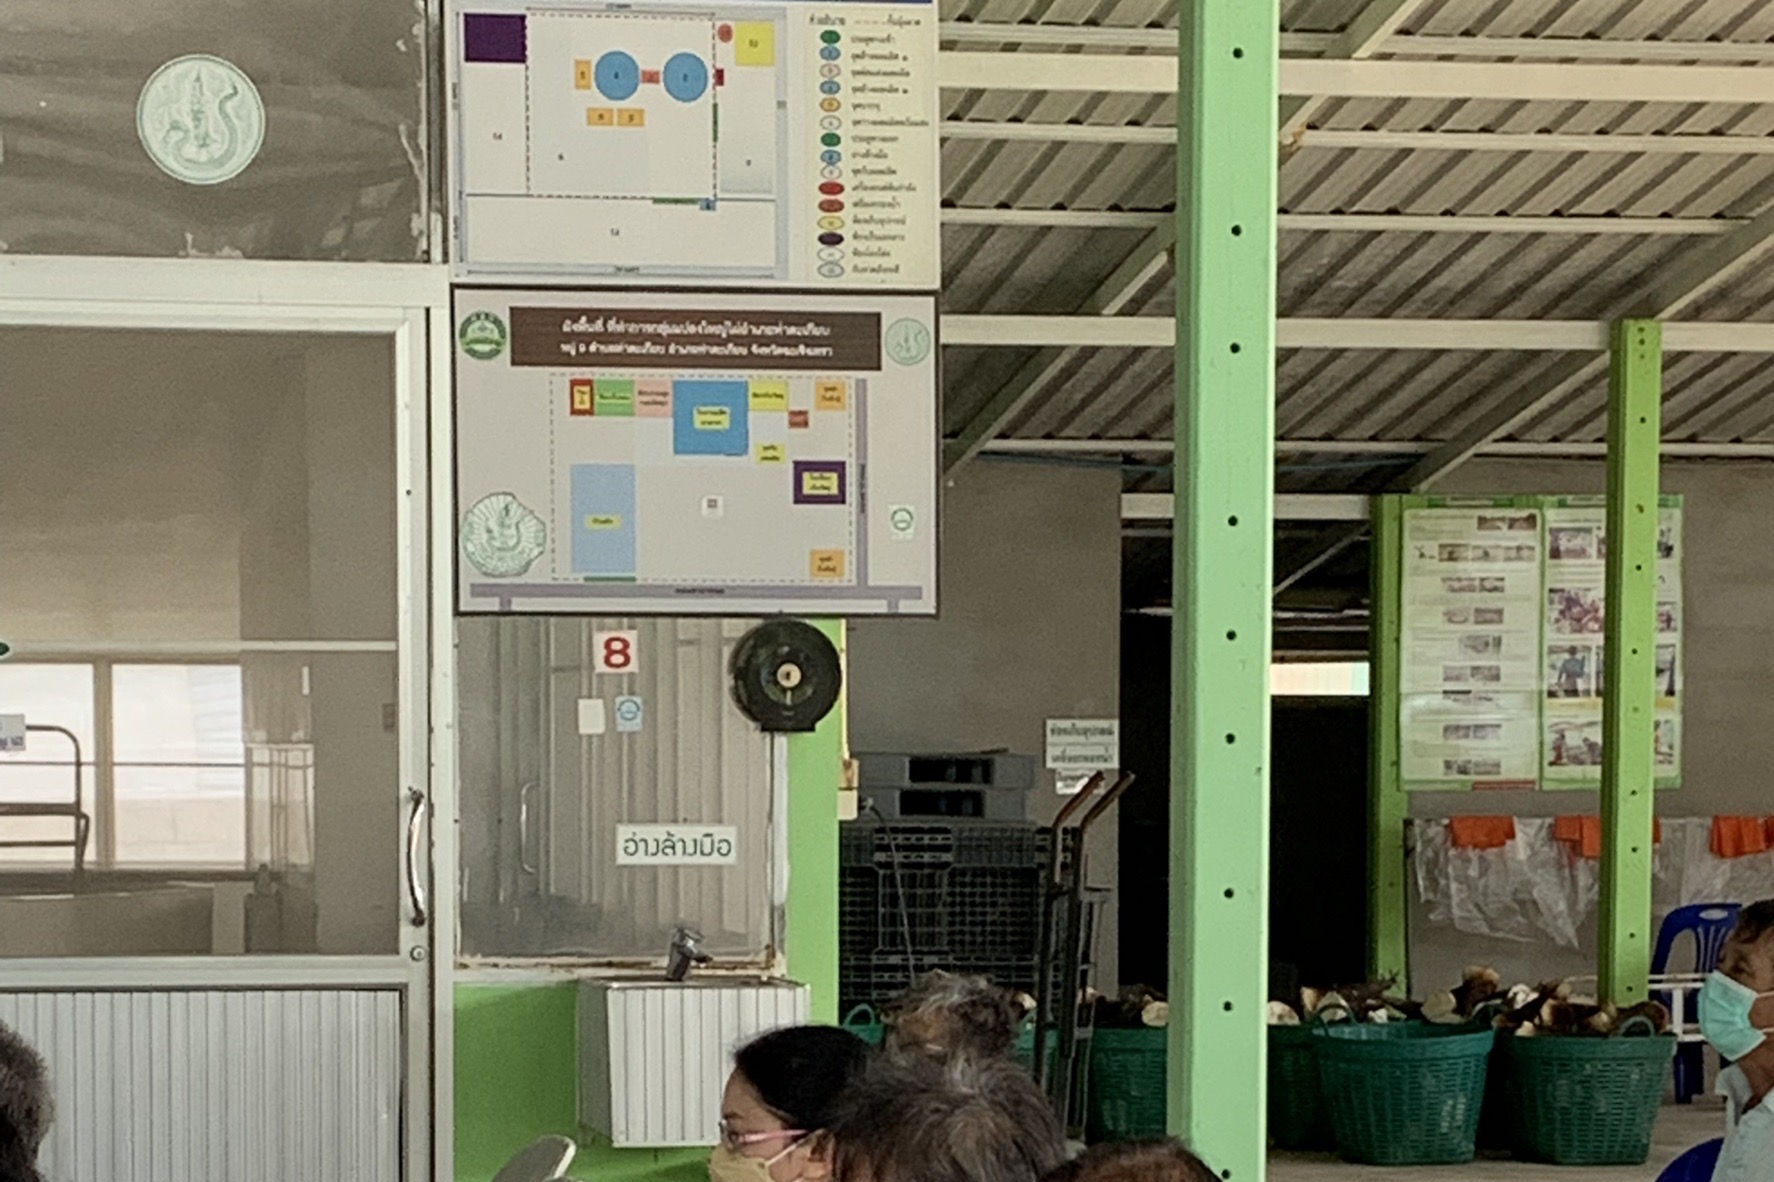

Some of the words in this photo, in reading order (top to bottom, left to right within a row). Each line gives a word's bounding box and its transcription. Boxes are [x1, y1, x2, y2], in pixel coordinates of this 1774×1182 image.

[603, 636, 631, 669] 8
[622, 830, 734, 858] อ่างล้างมือ
